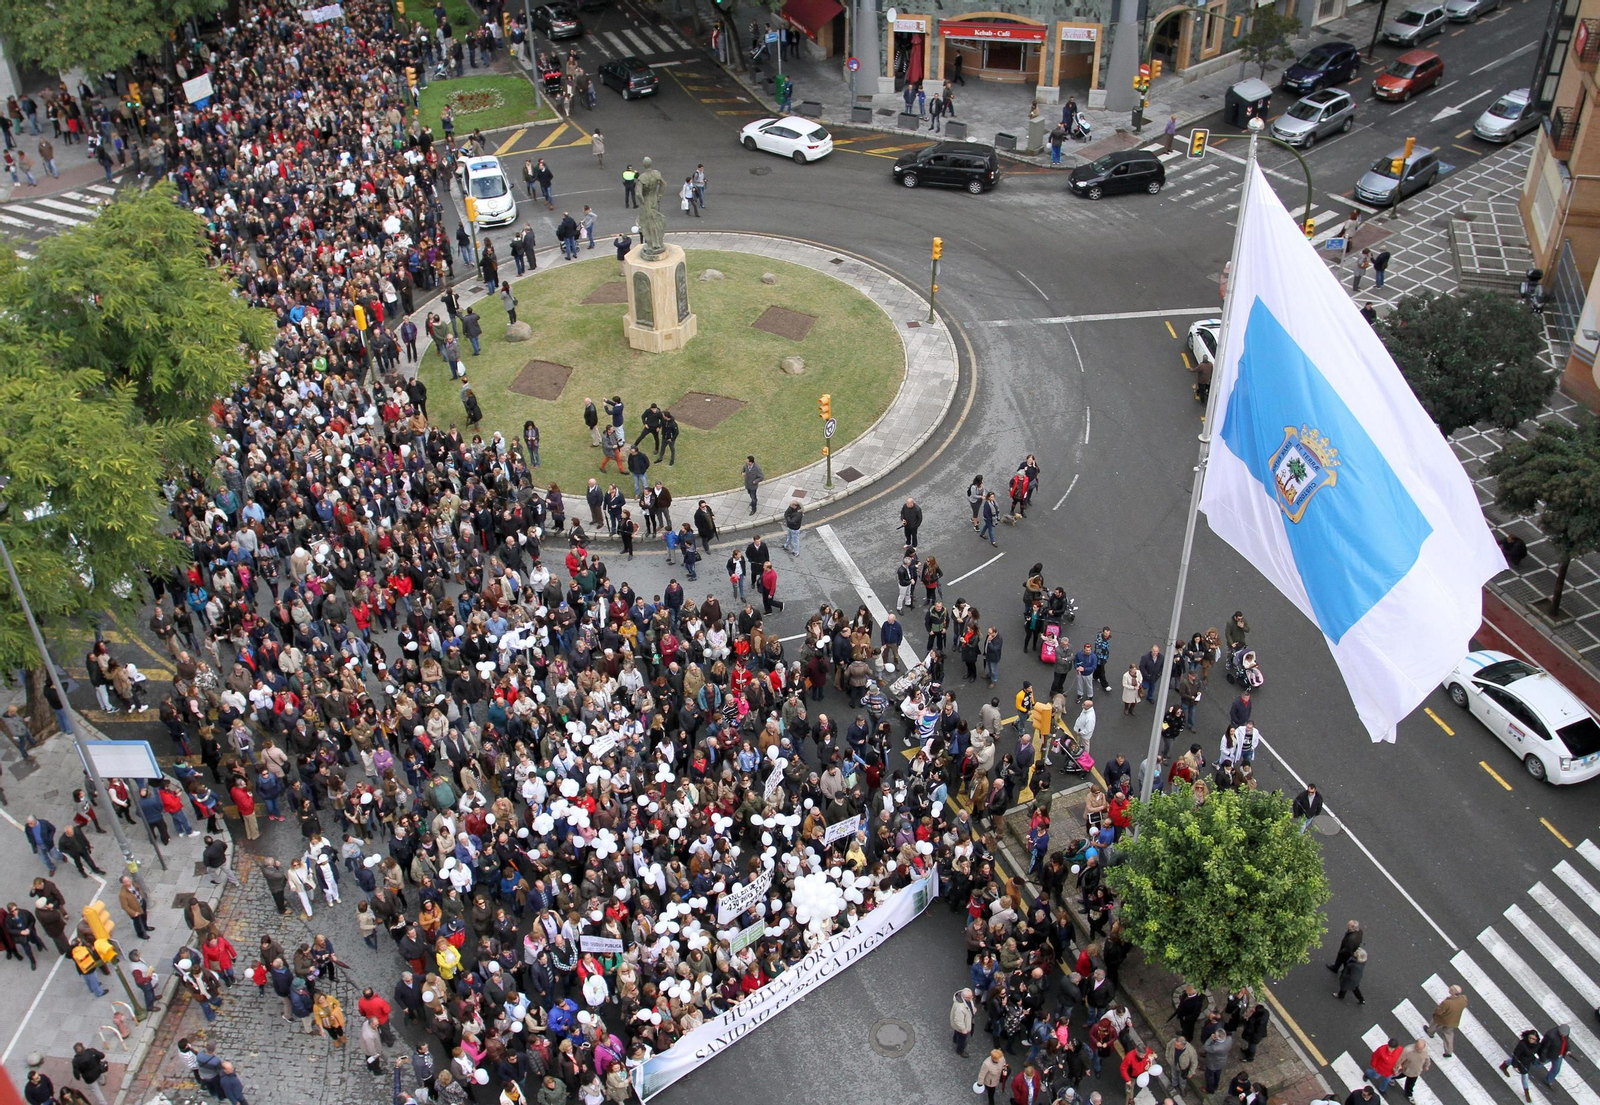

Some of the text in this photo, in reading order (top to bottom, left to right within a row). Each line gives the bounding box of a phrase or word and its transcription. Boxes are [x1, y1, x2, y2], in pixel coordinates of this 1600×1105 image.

[1295, 443, 1303, 451] ET
[695, 1008, 770, 1062] SANIDAD
[845, 922, 894, 961] DIGNA
[723, 925, 862, 1026] HUELVA, POR UNA
